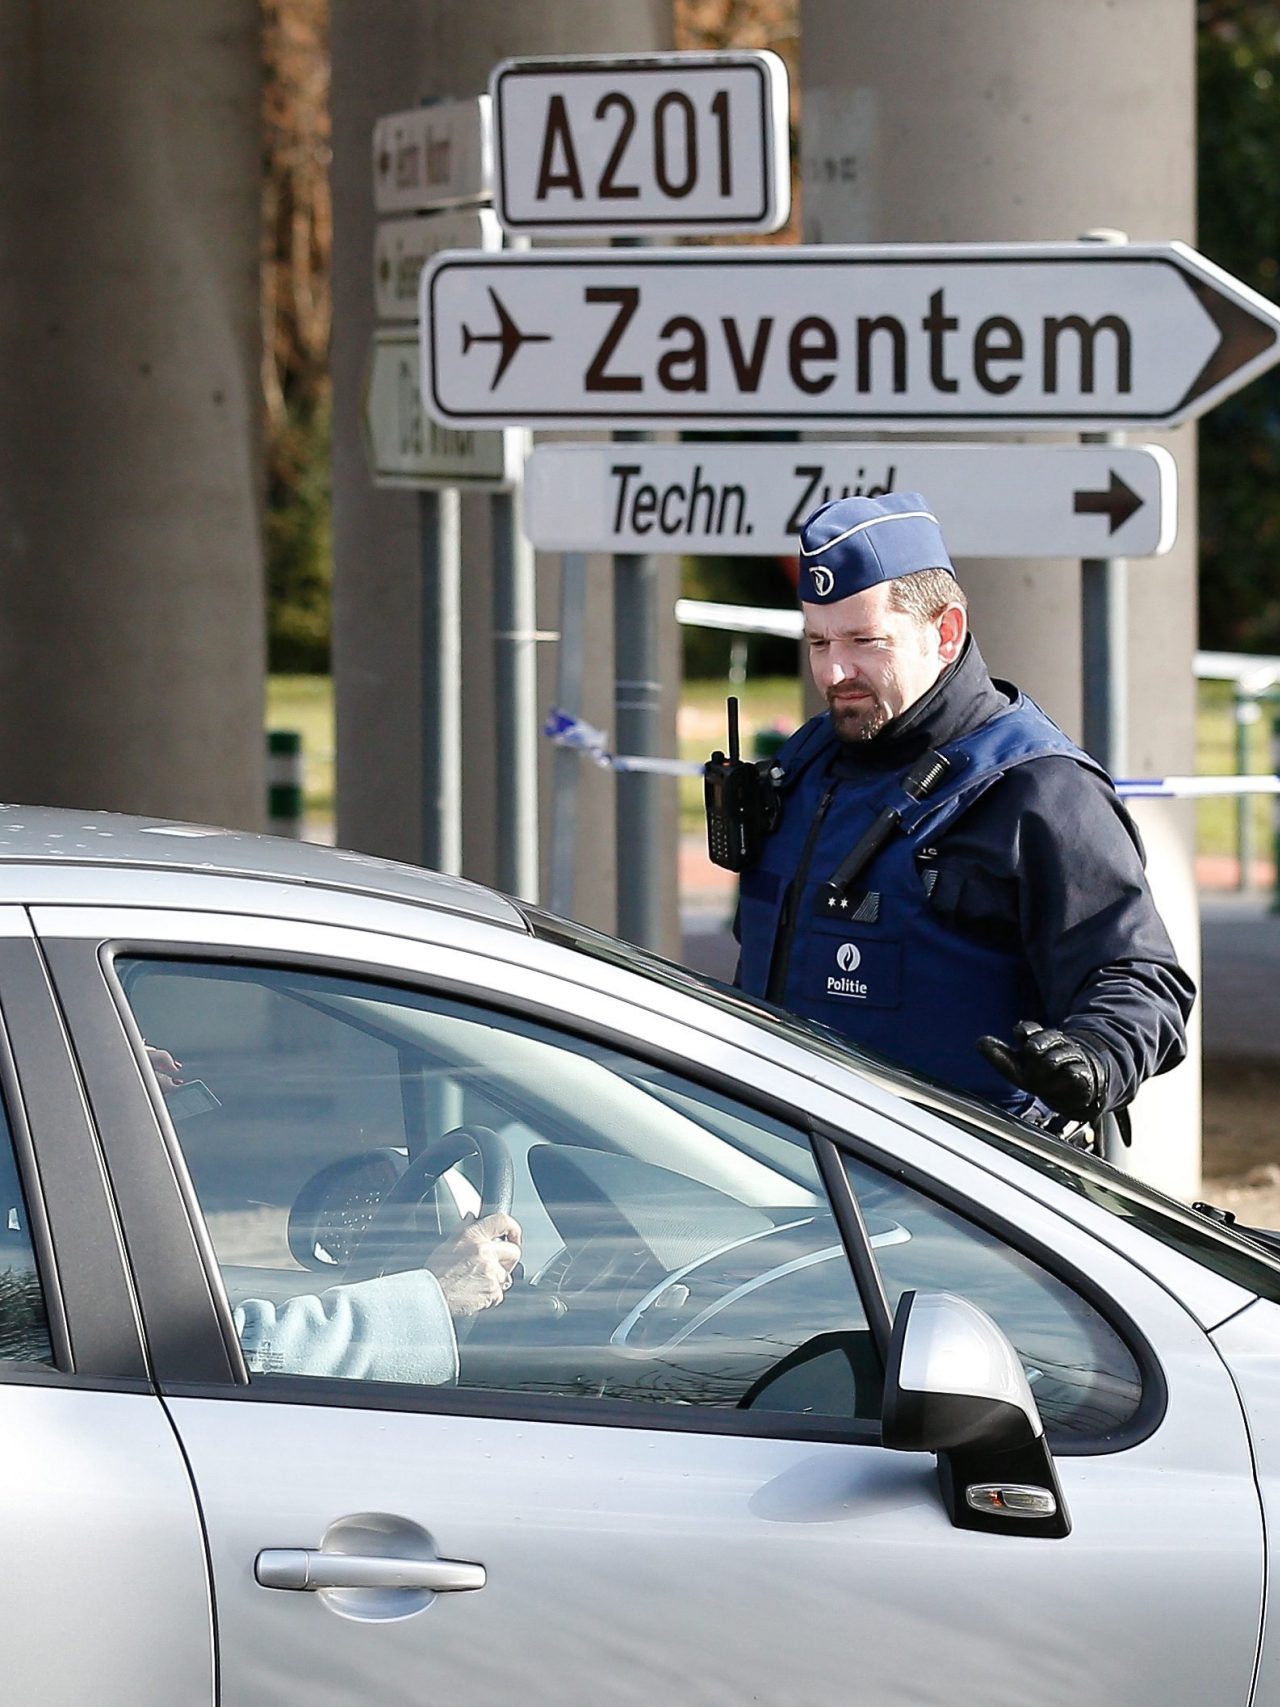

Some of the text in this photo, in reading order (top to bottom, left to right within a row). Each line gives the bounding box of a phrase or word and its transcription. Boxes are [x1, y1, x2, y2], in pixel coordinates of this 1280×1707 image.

[536, 91, 733, 201] A201
[584, 286, 1132, 395] Zaventem
[611, 464, 754, 535] Techn.
[827, 976, 868, 994] Politie
